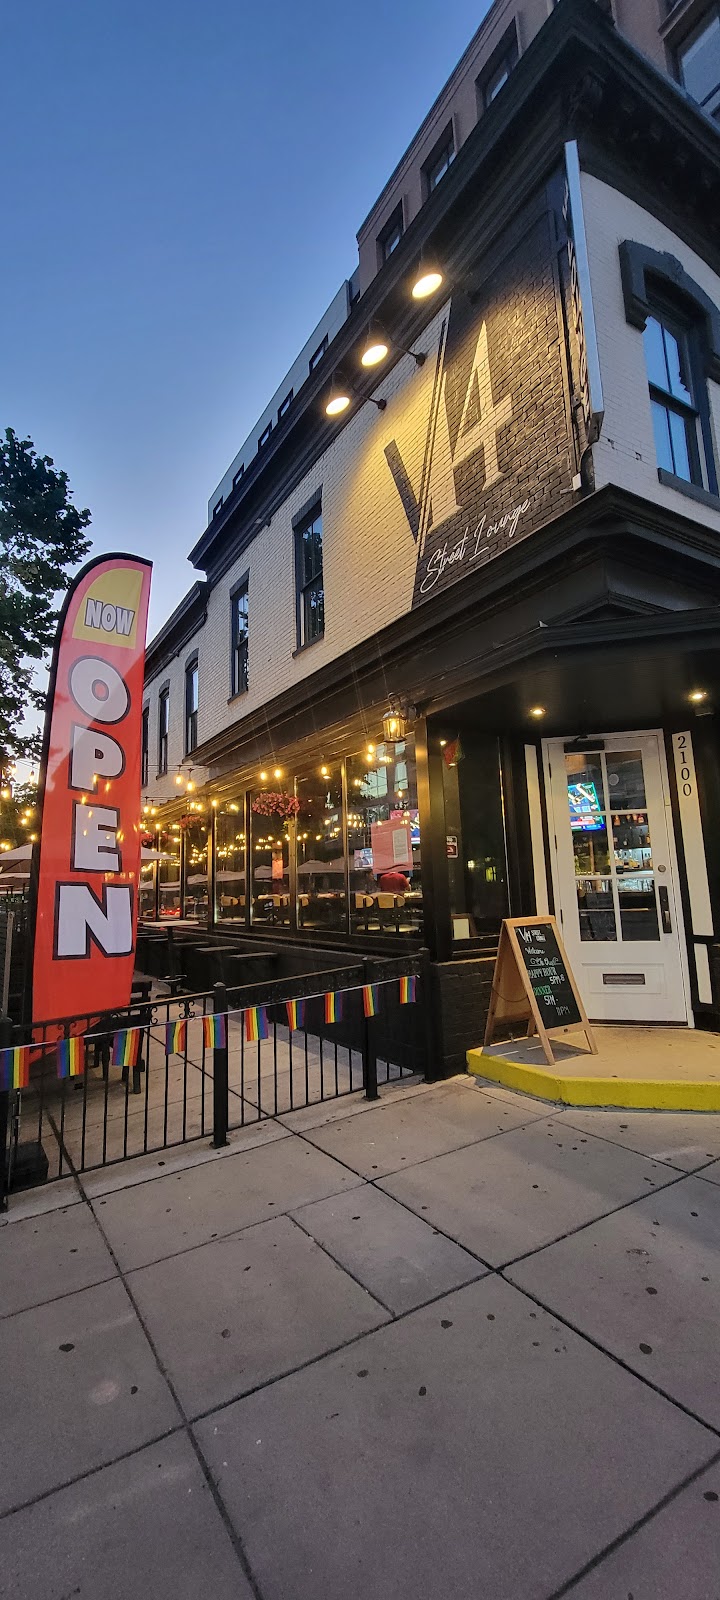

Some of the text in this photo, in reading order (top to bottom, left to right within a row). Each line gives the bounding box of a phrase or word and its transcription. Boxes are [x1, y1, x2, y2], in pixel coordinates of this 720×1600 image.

[420, 499, 531, 593] Street Lounge
[85, 597, 135, 636] NOW
[677, 736, 691, 796] 2100
[53, 655, 134, 960] OPEN
